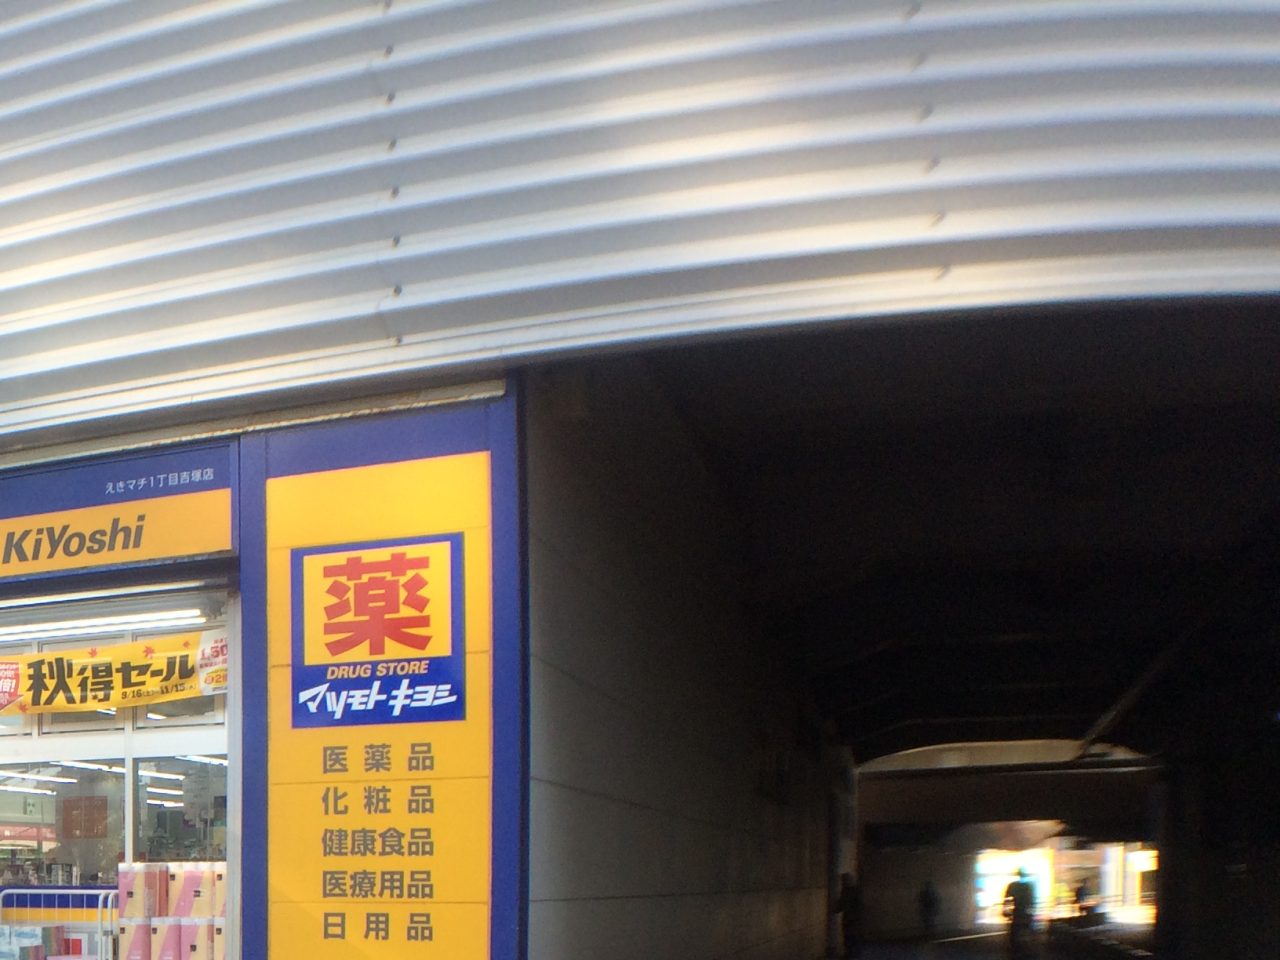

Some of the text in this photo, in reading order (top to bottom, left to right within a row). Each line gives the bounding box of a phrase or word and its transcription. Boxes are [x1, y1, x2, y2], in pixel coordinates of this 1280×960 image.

[2, 514, 146, 564] KiYoshi
[323, 552, 433, 657] 薬
[26, 653, 196, 706] 秋得セール
[326, 660, 429, 680] DRUG STORE
[321, 827, 434, 857] 健康食品
[322, 869, 434, 899] 医療用品
